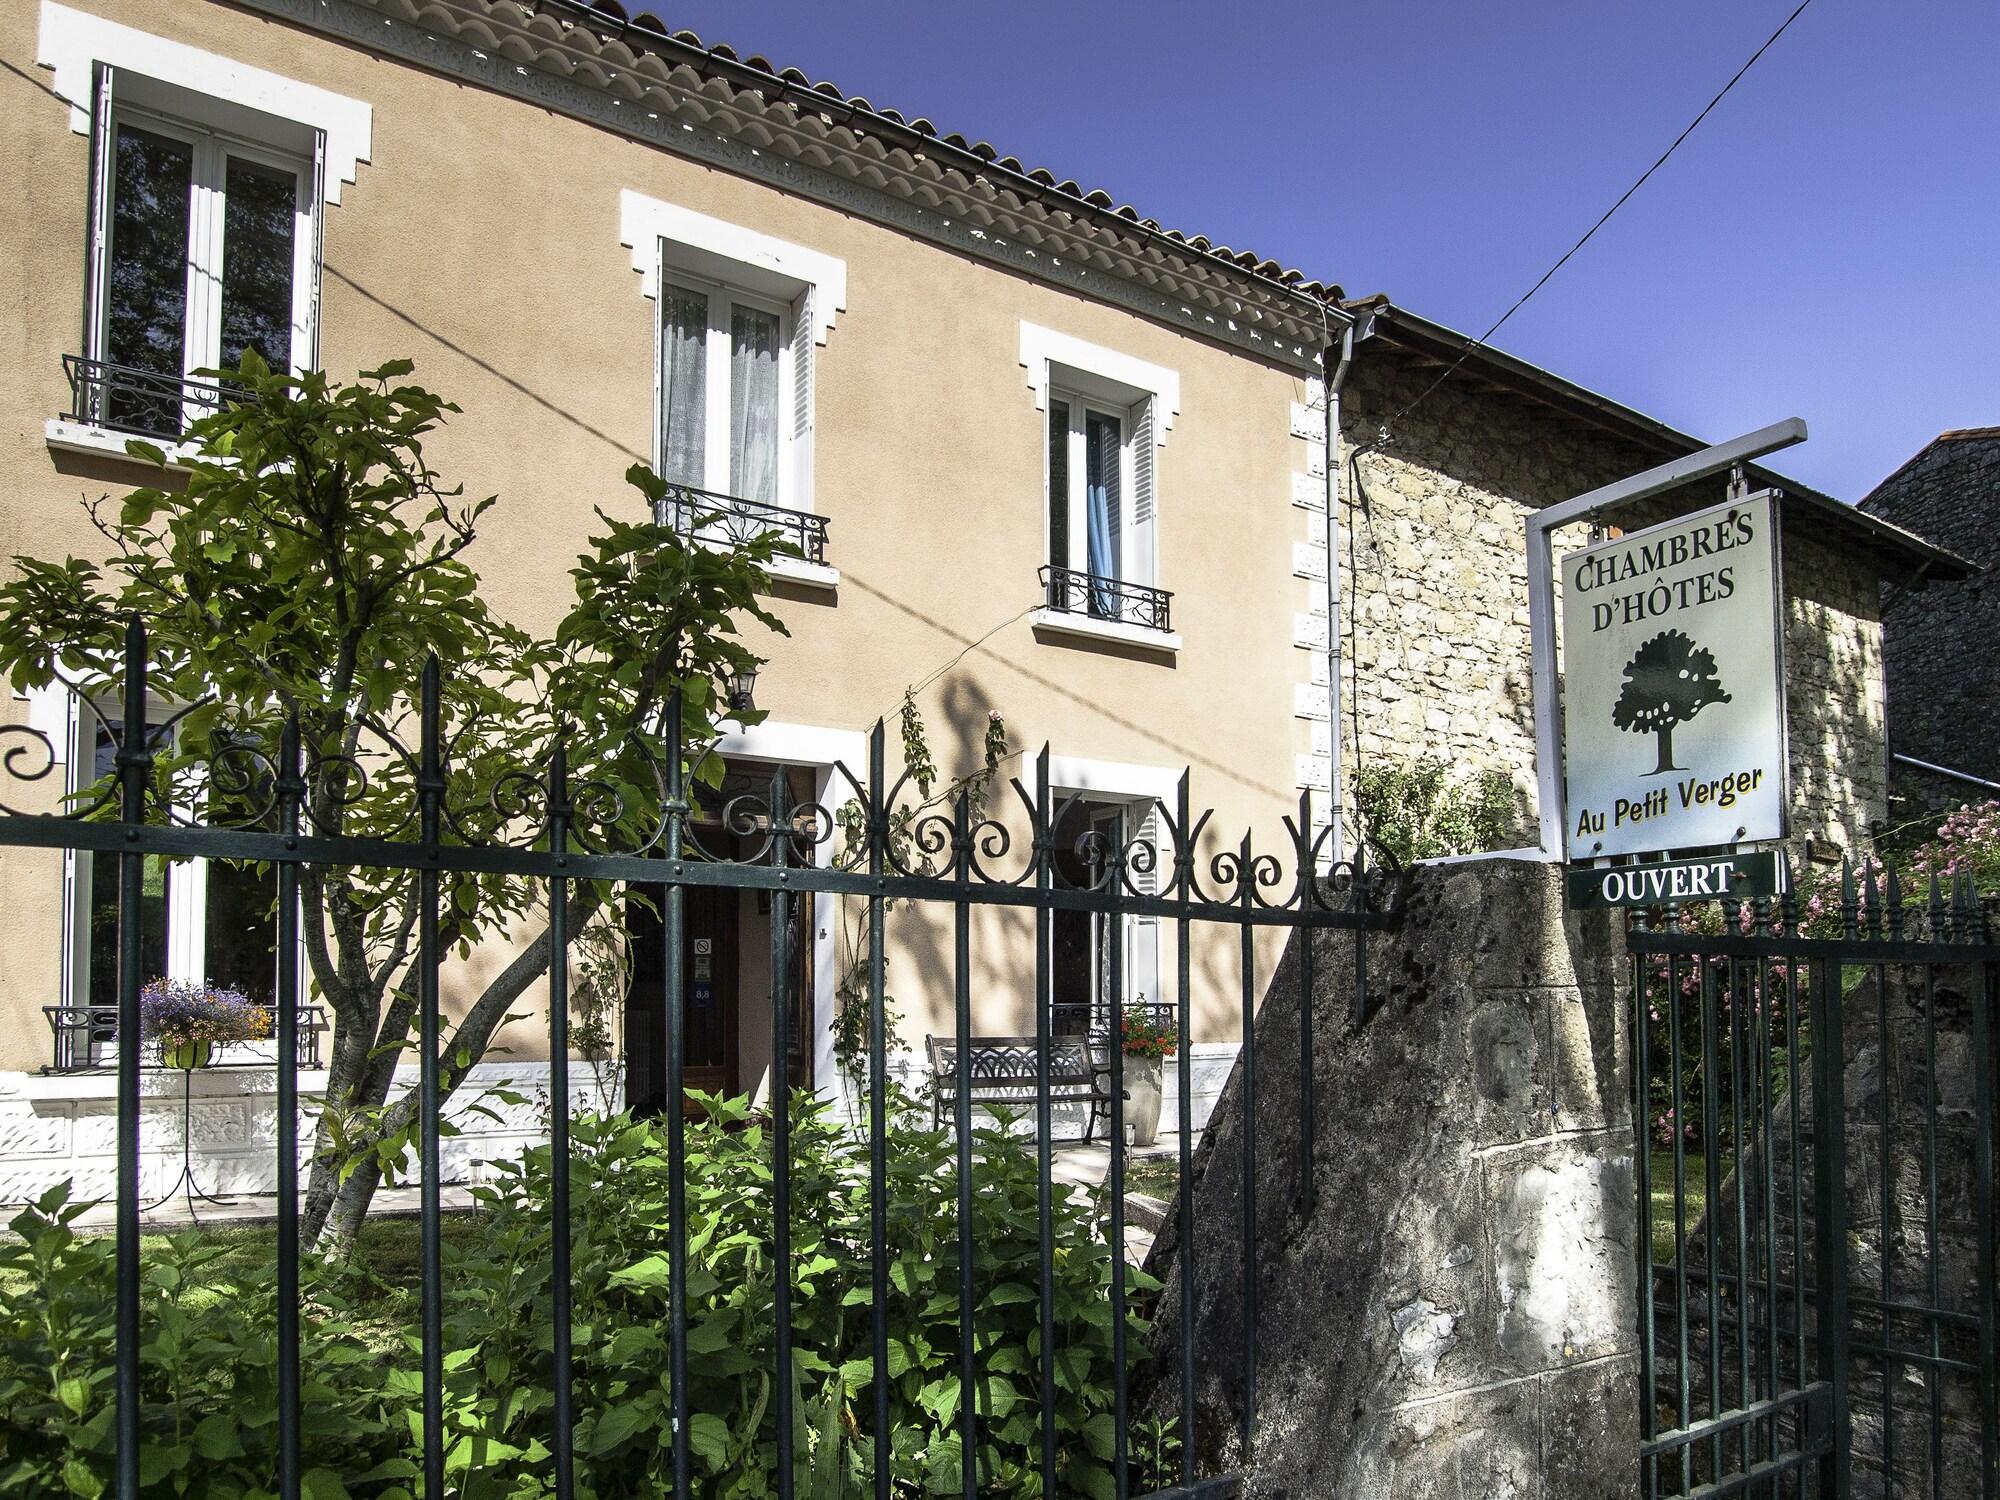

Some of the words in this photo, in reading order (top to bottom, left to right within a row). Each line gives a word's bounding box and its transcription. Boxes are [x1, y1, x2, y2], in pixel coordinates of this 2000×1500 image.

[1575, 512, 1754, 593] CHAMBRES
[1592, 566, 1734, 632] D’HÔTES
[1576, 809, 1605, 837] Au
[1614, 787, 1669, 827] Petit
[1677, 768, 1763, 808] Verger
[1602, 861, 1734, 902] OUVERT
